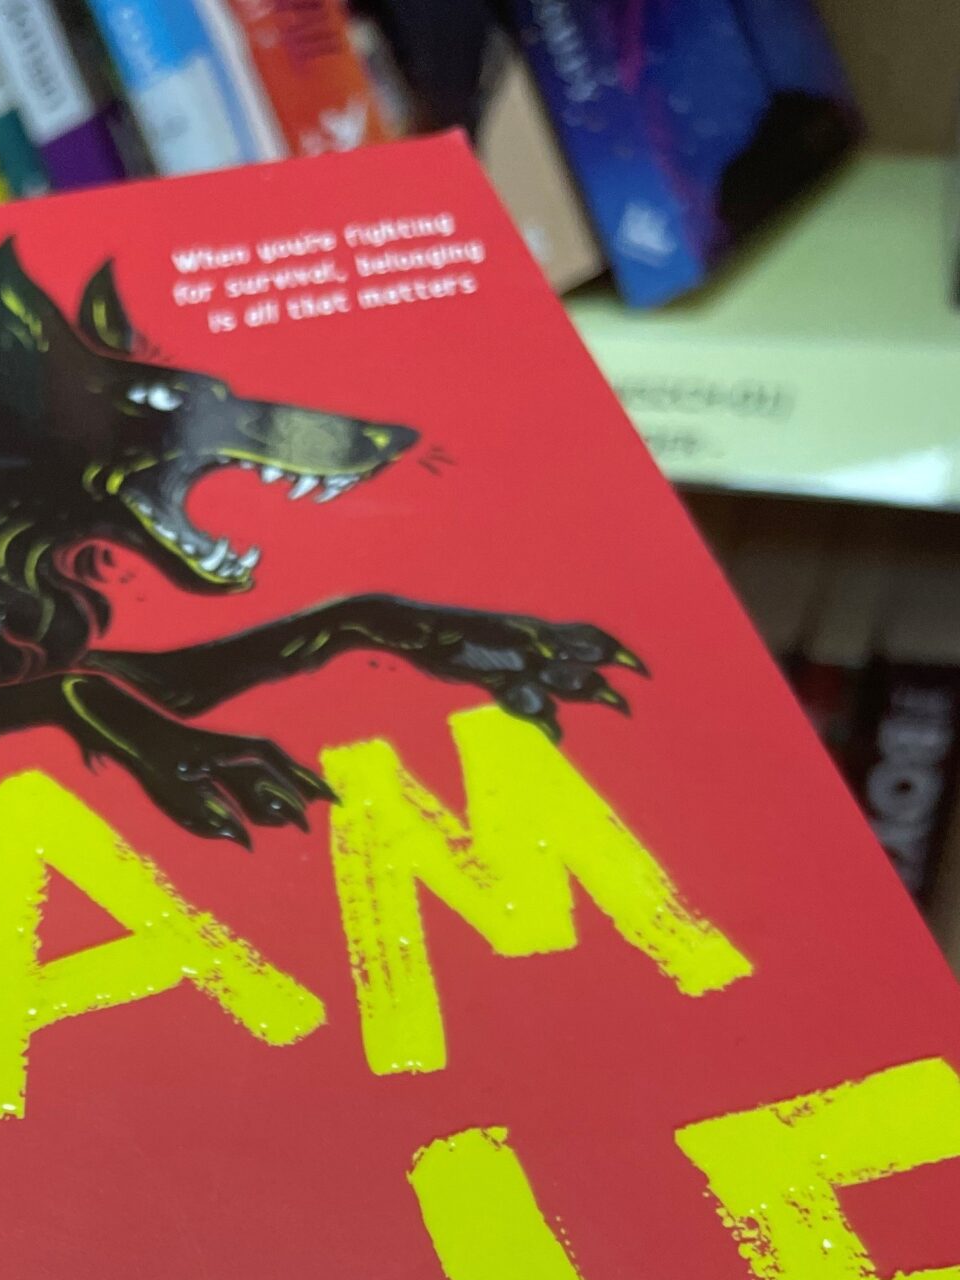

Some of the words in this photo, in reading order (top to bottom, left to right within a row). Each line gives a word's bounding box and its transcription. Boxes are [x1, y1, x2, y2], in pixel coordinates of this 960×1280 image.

[172, 247, 251, 274] When
[257, 231, 337, 263] you're
[172, 280, 214, 306] for
[224, 260, 348, 298] survival,
[354, 240, 486, 277] belonging
[207, 310, 237, 333] is
[243, 300, 280, 328] all
[287, 290, 351, 320] that
[357, 273, 478, 310] matters
